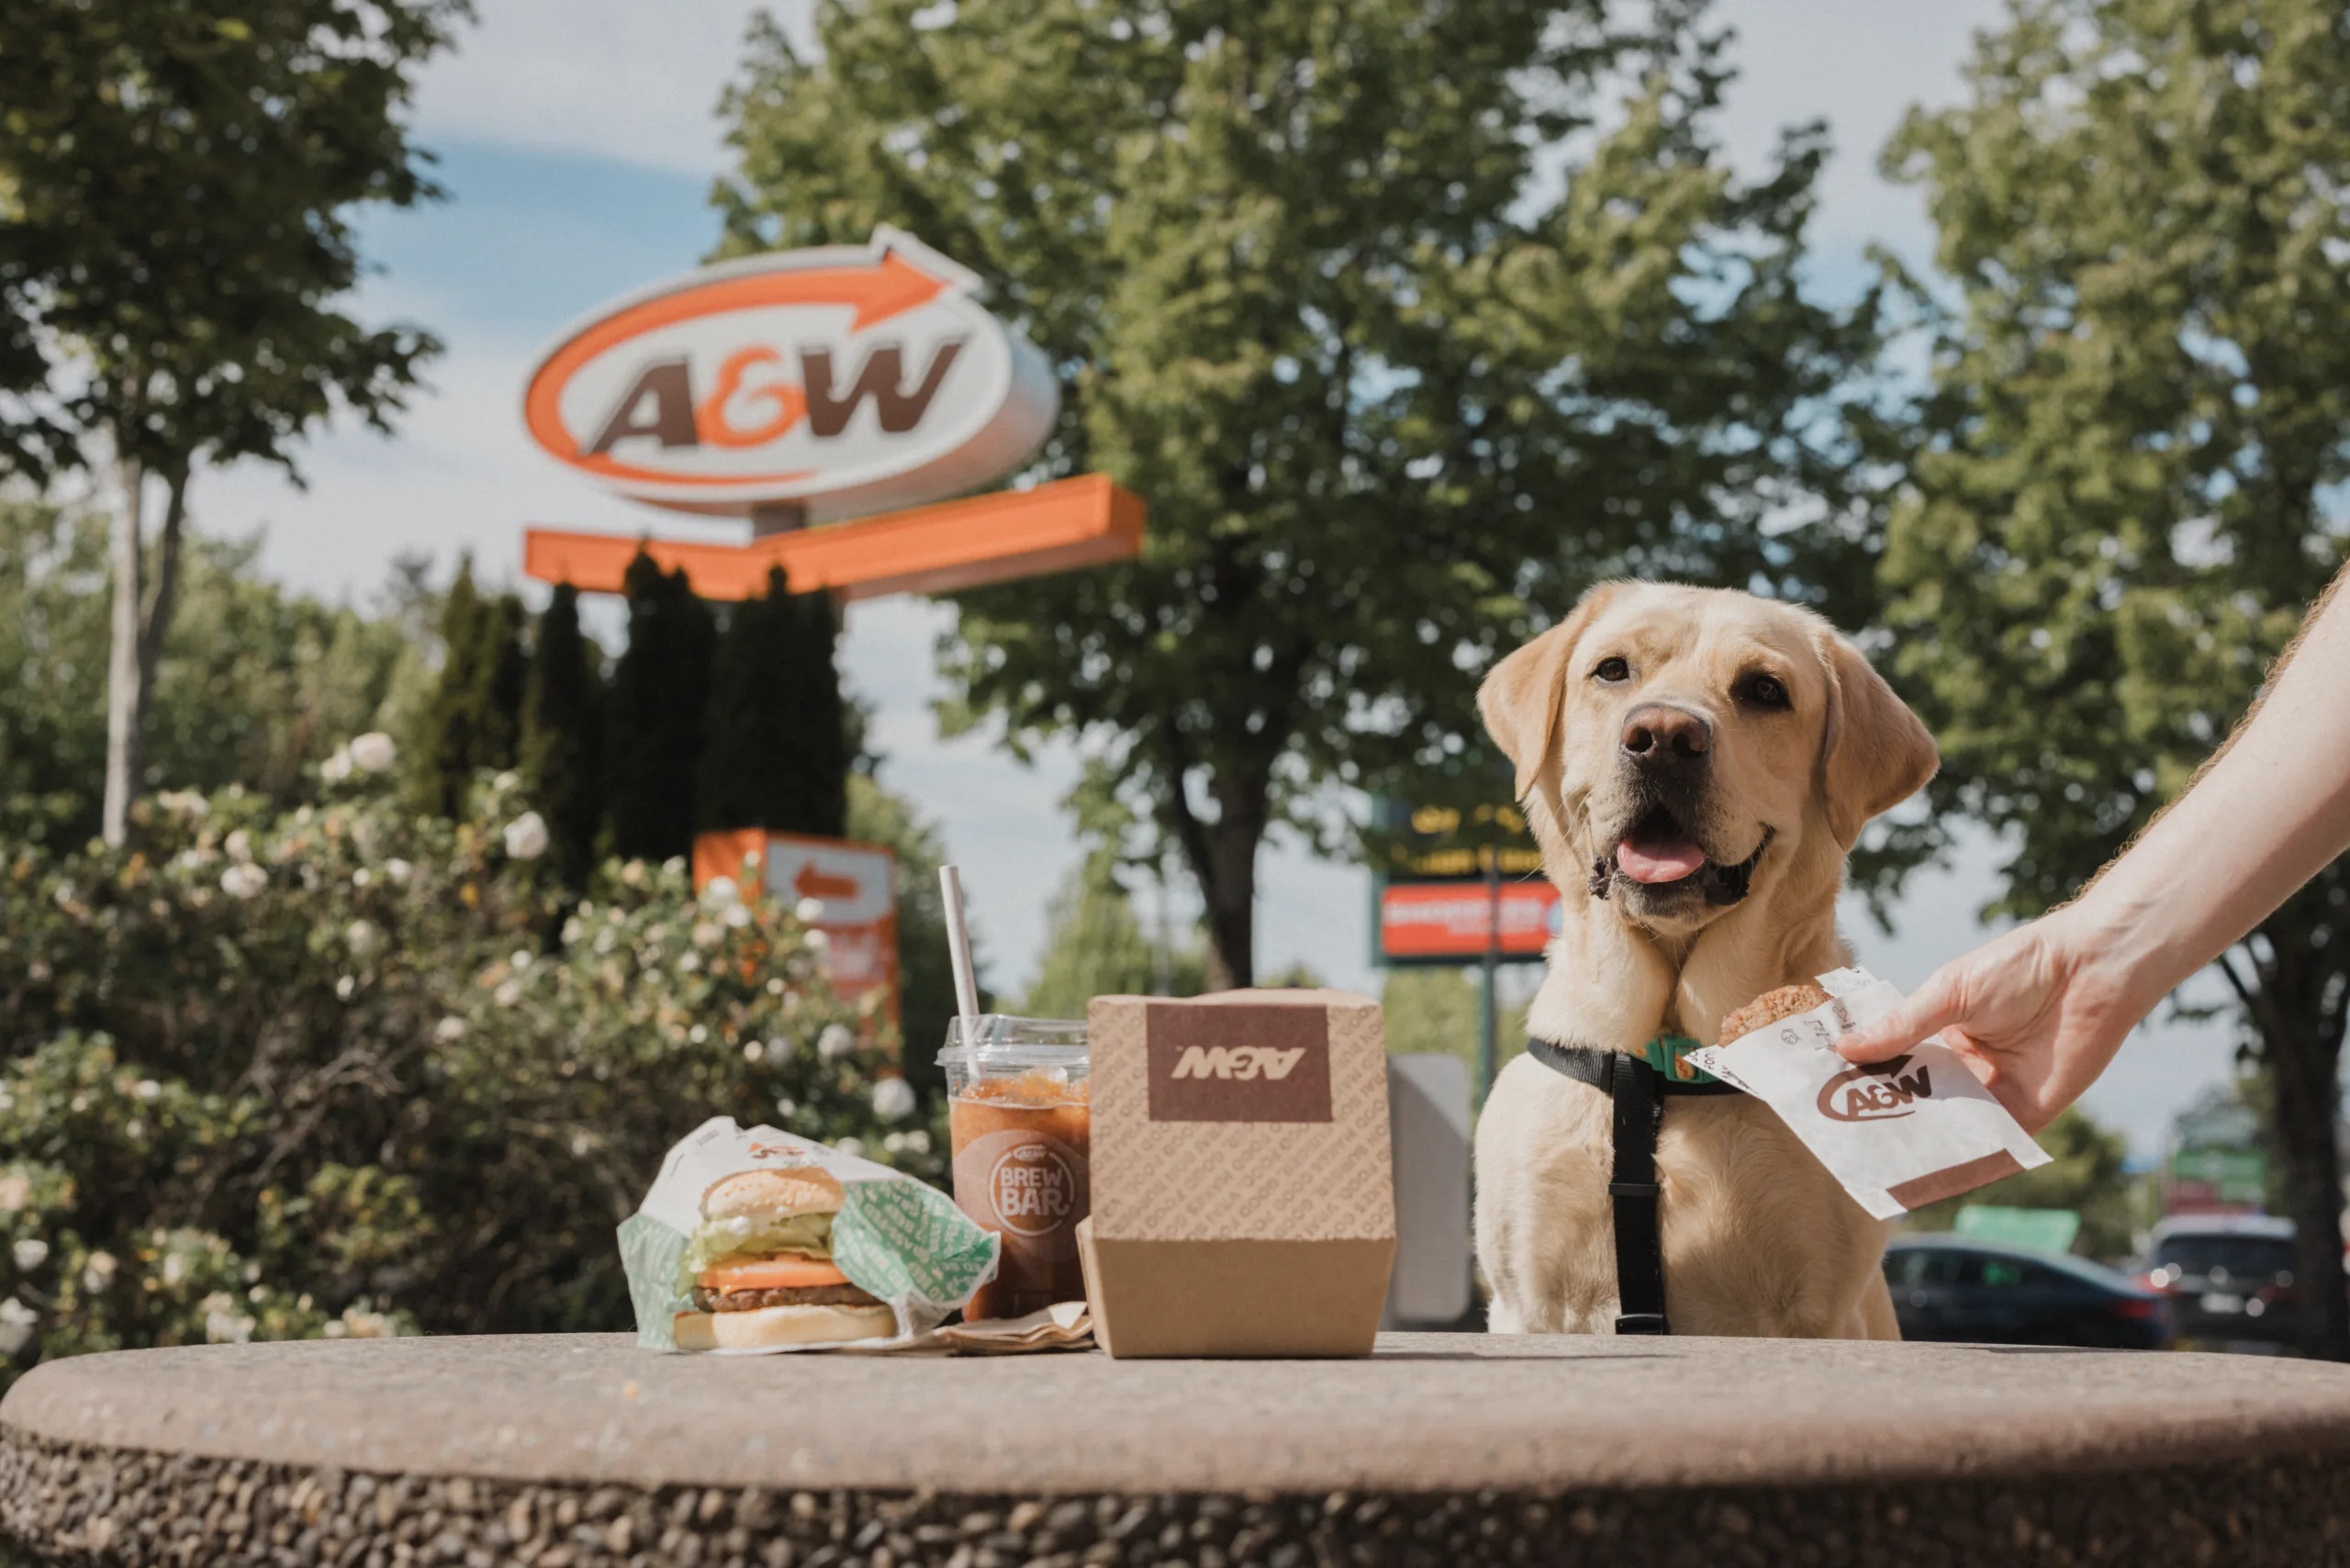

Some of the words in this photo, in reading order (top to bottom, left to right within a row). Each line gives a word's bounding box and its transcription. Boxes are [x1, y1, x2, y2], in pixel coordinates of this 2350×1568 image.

[588, 338, 967, 454] A&W
[1170, 1045, 1306, 1081] A&W
[1845, 1065, 1933, 1117] A&W
[1001, 1167, 1062, 1187] BREW
[1002, 1188, 1070, 1216] BAR
